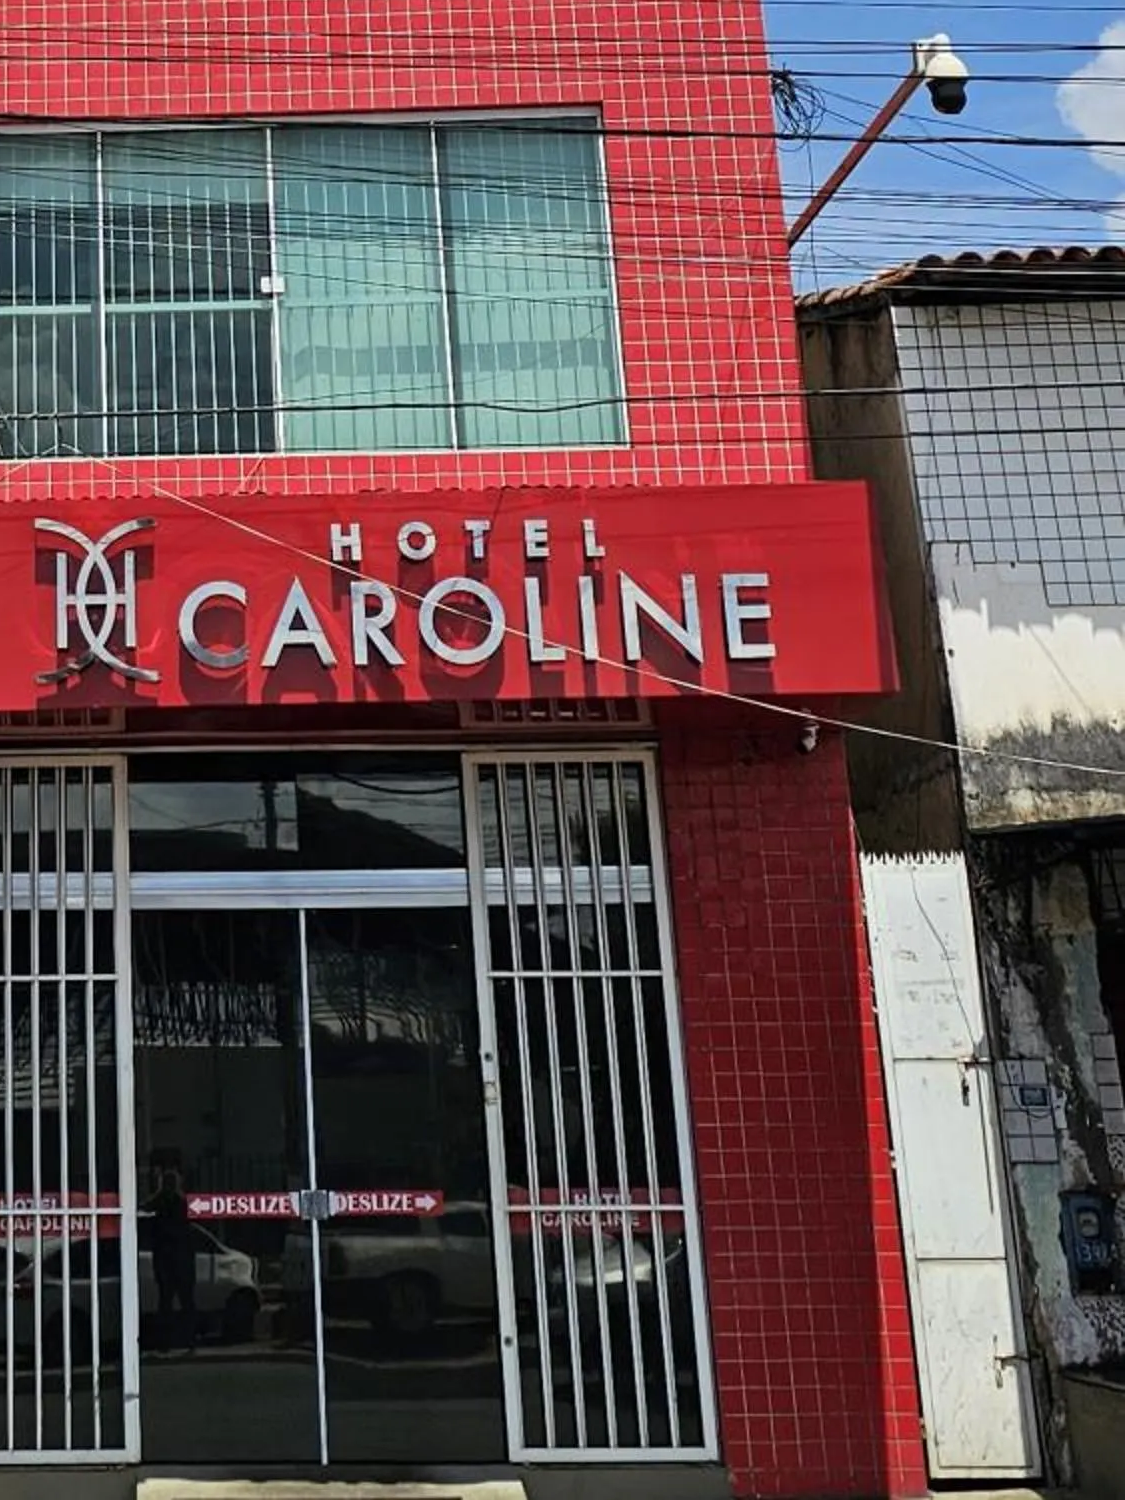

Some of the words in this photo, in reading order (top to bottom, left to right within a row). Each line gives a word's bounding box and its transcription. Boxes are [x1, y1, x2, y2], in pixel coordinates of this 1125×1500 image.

[330, 518, 607, 563] HOTEL
[178, 569, 777, 670] CAROLINE
[212, 1194, 292, 1215] DESLIZE
[336, 1192, 415, 1213] DESLIZE
